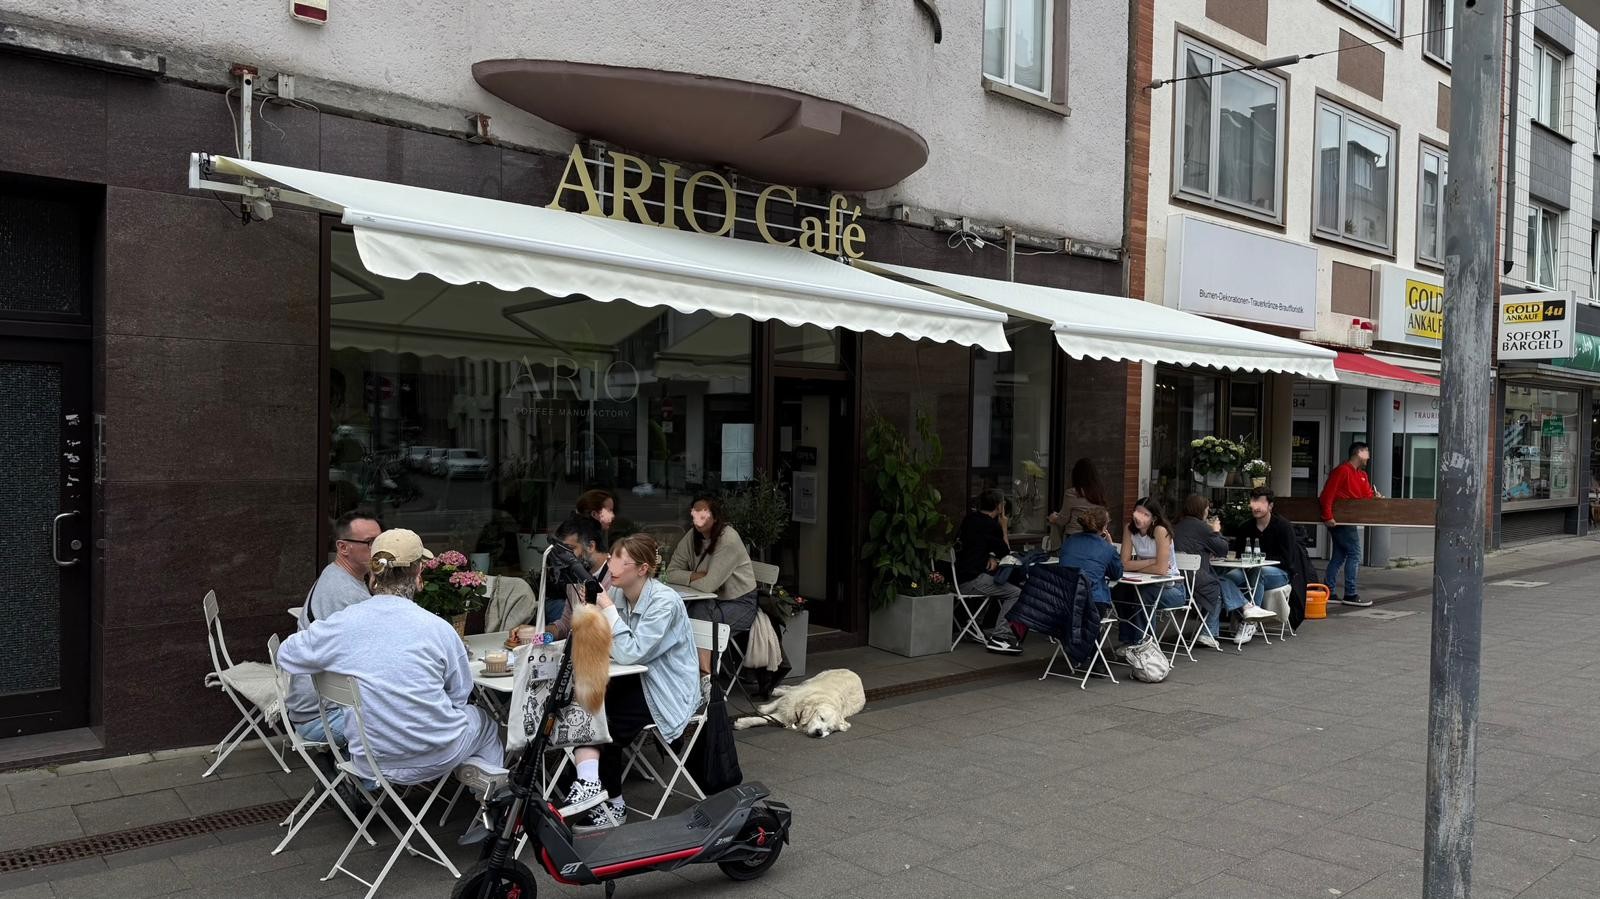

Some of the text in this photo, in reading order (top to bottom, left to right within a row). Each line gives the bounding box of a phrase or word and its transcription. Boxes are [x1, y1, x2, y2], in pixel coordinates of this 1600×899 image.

[544, 143, 866, 259] ARIO Café
[1408, 286, 1443, 314] GOLD
[1505, 303, 1541, 315] GOLD
[1544, 306, 1563, 317] 4u
[1407, 312, 1443, 333] ANKAUF
[1505, 313, 1538, 321] ANKAUF
[1506, 329, 1560, 342] SOFORT
[1502, 339, 1563, 351] BARGELD
[505, 355, 640, 403] ARIO
[513, 407, 557, 416] COFFEE
